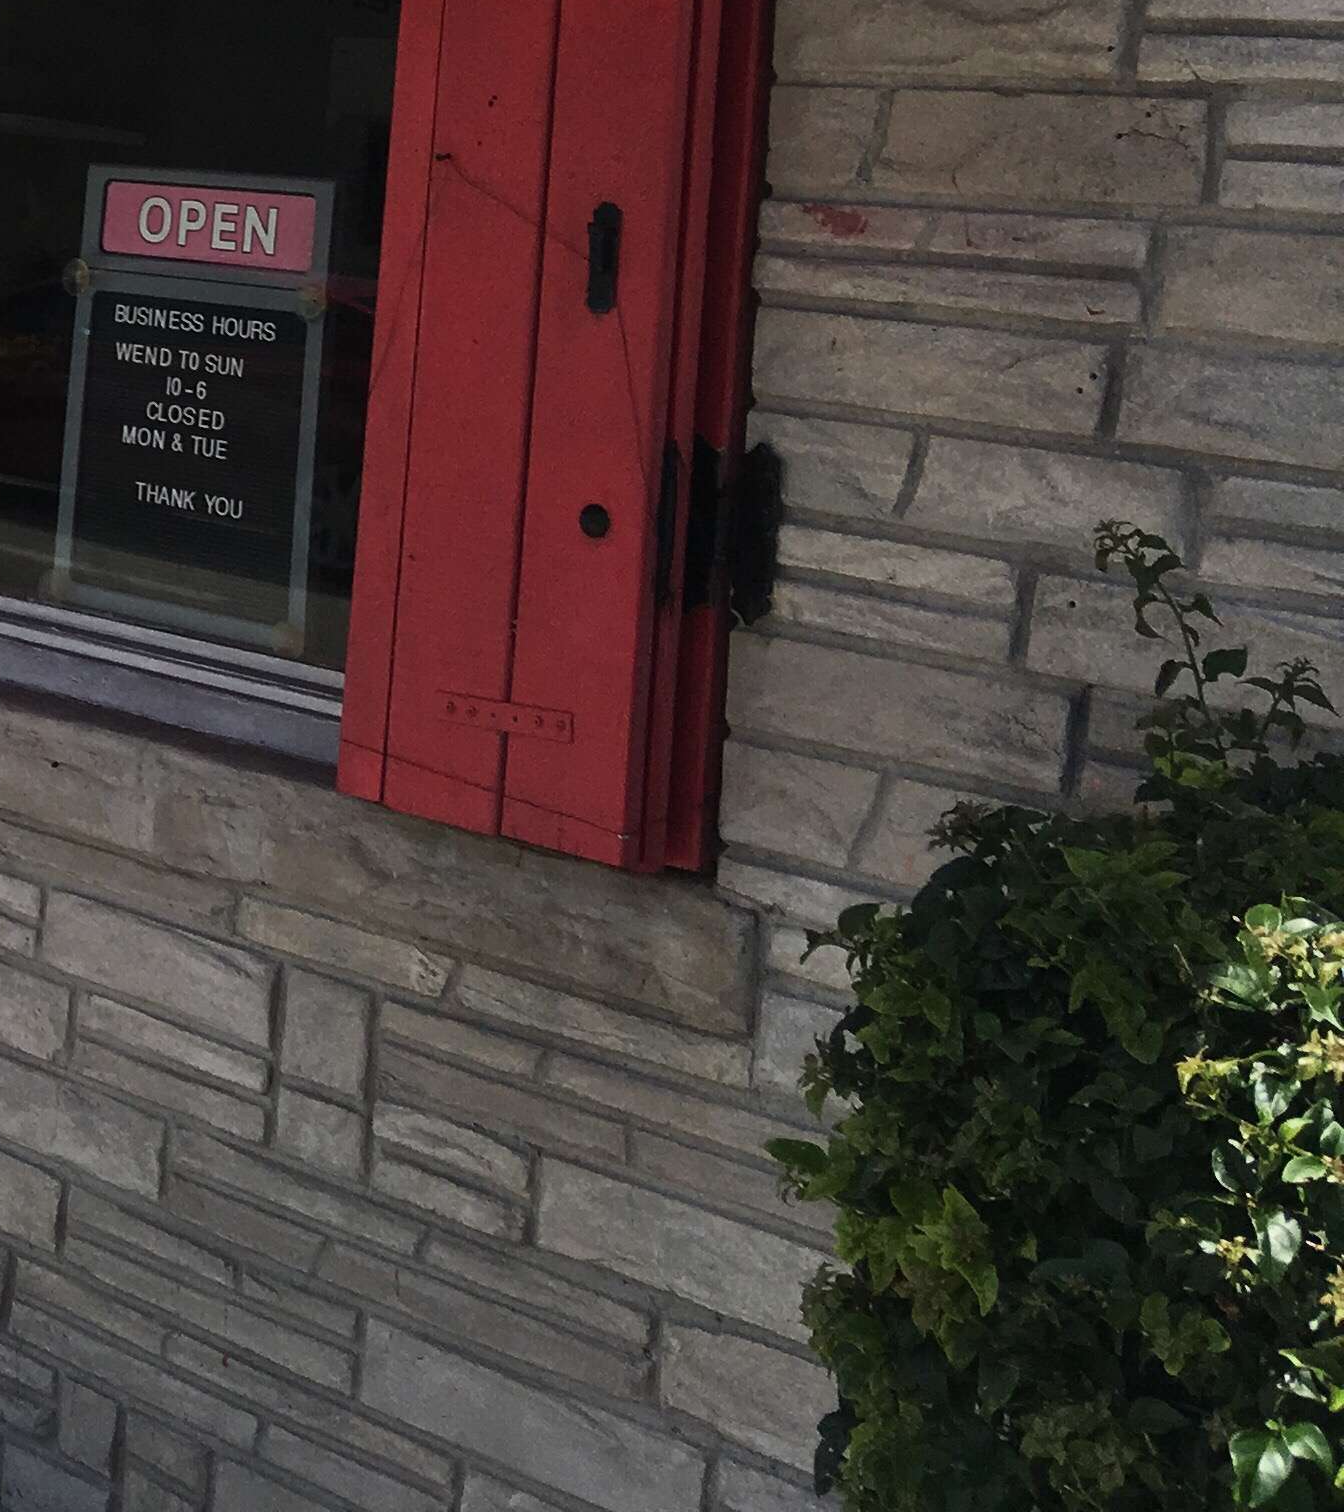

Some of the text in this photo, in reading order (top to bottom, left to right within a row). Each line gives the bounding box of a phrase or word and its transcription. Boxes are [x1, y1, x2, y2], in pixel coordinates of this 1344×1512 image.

[138, 196, 279, 256] OPEN
[114, 303, 277, 342] BUSINESS HOURS
[115, 341, 244, 378] WEND TO SUN
[146, 401, 225, 430] CLOSED
[121, 425, 228, 460] MON & TUE
[135, 481, 243, 519] THANK YOU
